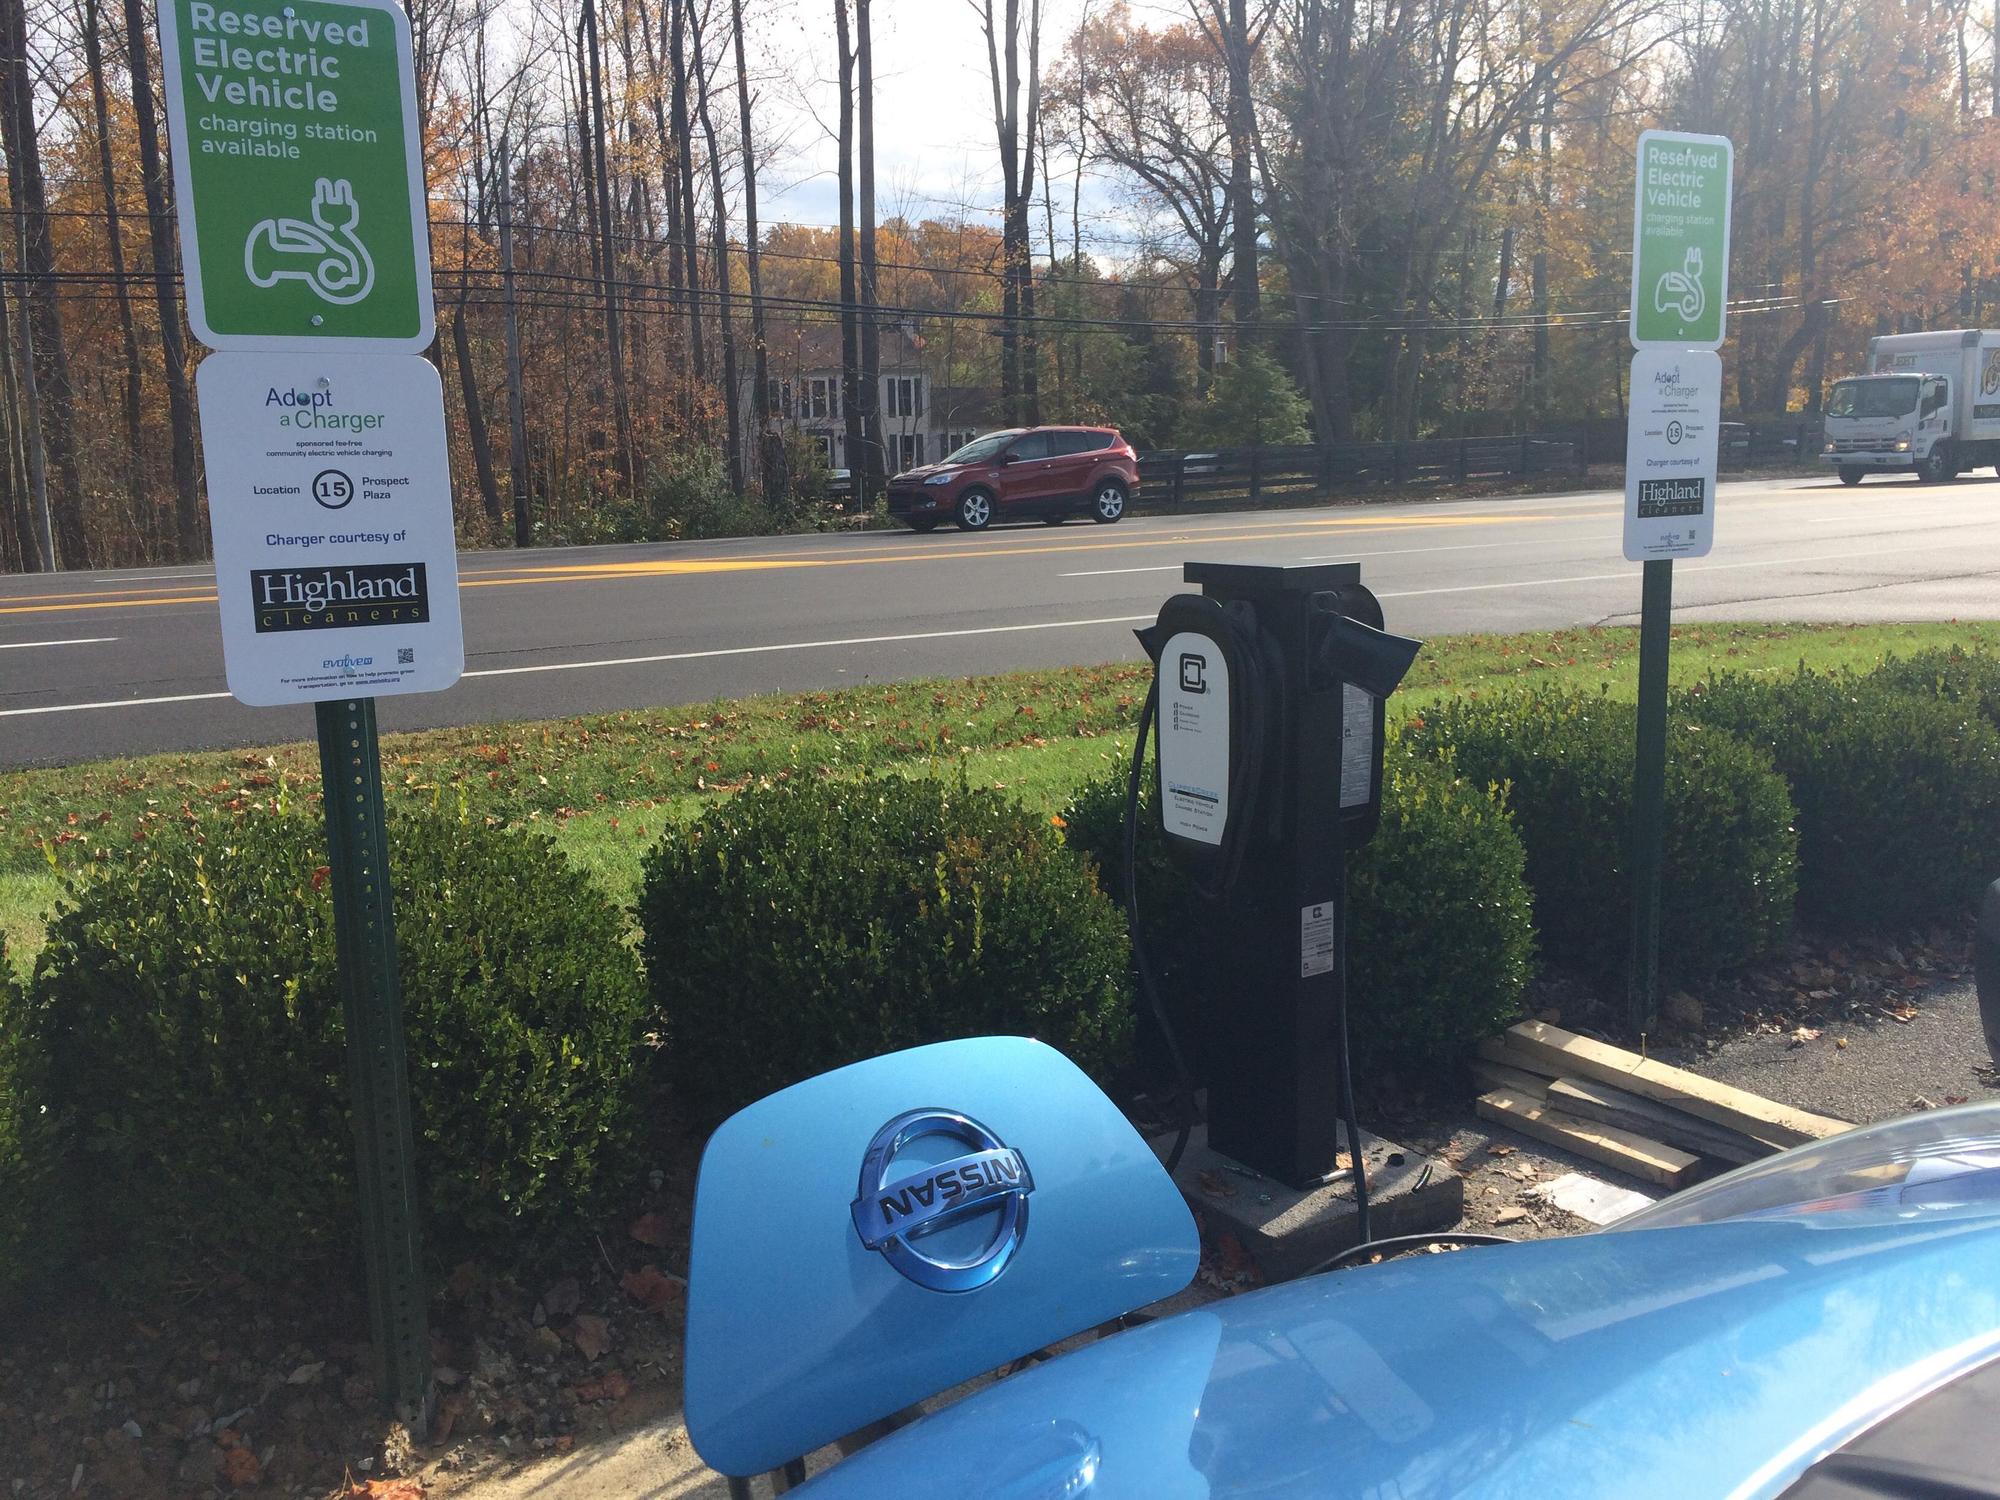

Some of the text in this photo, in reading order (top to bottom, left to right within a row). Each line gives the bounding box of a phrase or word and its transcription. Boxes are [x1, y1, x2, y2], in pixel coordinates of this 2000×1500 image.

[190, 2, 369, 48] Reserved
[193, 37, 340, 79] Electric
[195, 72, 338, 112] Vehicle
[199, 114, 377, 143] charging station
[201, 139, 300, 159] available
[1649, 147, 1717, 168] Reserved
[1648, 168, 1704, 188] Electric
[1647, 188, 1702, 208] Vehicle
[1655, 371, 1680, 384] Adopt
[265, 387, 333, 412] Adopt
[1664, 384, 1699, 399] Charger
[280, 410, 385, 433] a Charger
[1670, 428, 1680, 438] 15
[266, 450, 306, 458] community
[336, 449, 361, 457] vehicle
[361, 449, 393, 457] charging
[296, 440, 334, 448] sponsored
[253, 481, 346, 498] Location 15
[362, 476, 409, 488] Prospect
[363, 490, 391, 500] Plaza
[1642, 481, 1701, 506] Highland
[266, 530, 407, 548] Charger courtesy of
[259, 567, 419, 613] Highland
[263, 609, 420, 627] cleaners
[879, 1158, 1017, 1225] NISSAN
